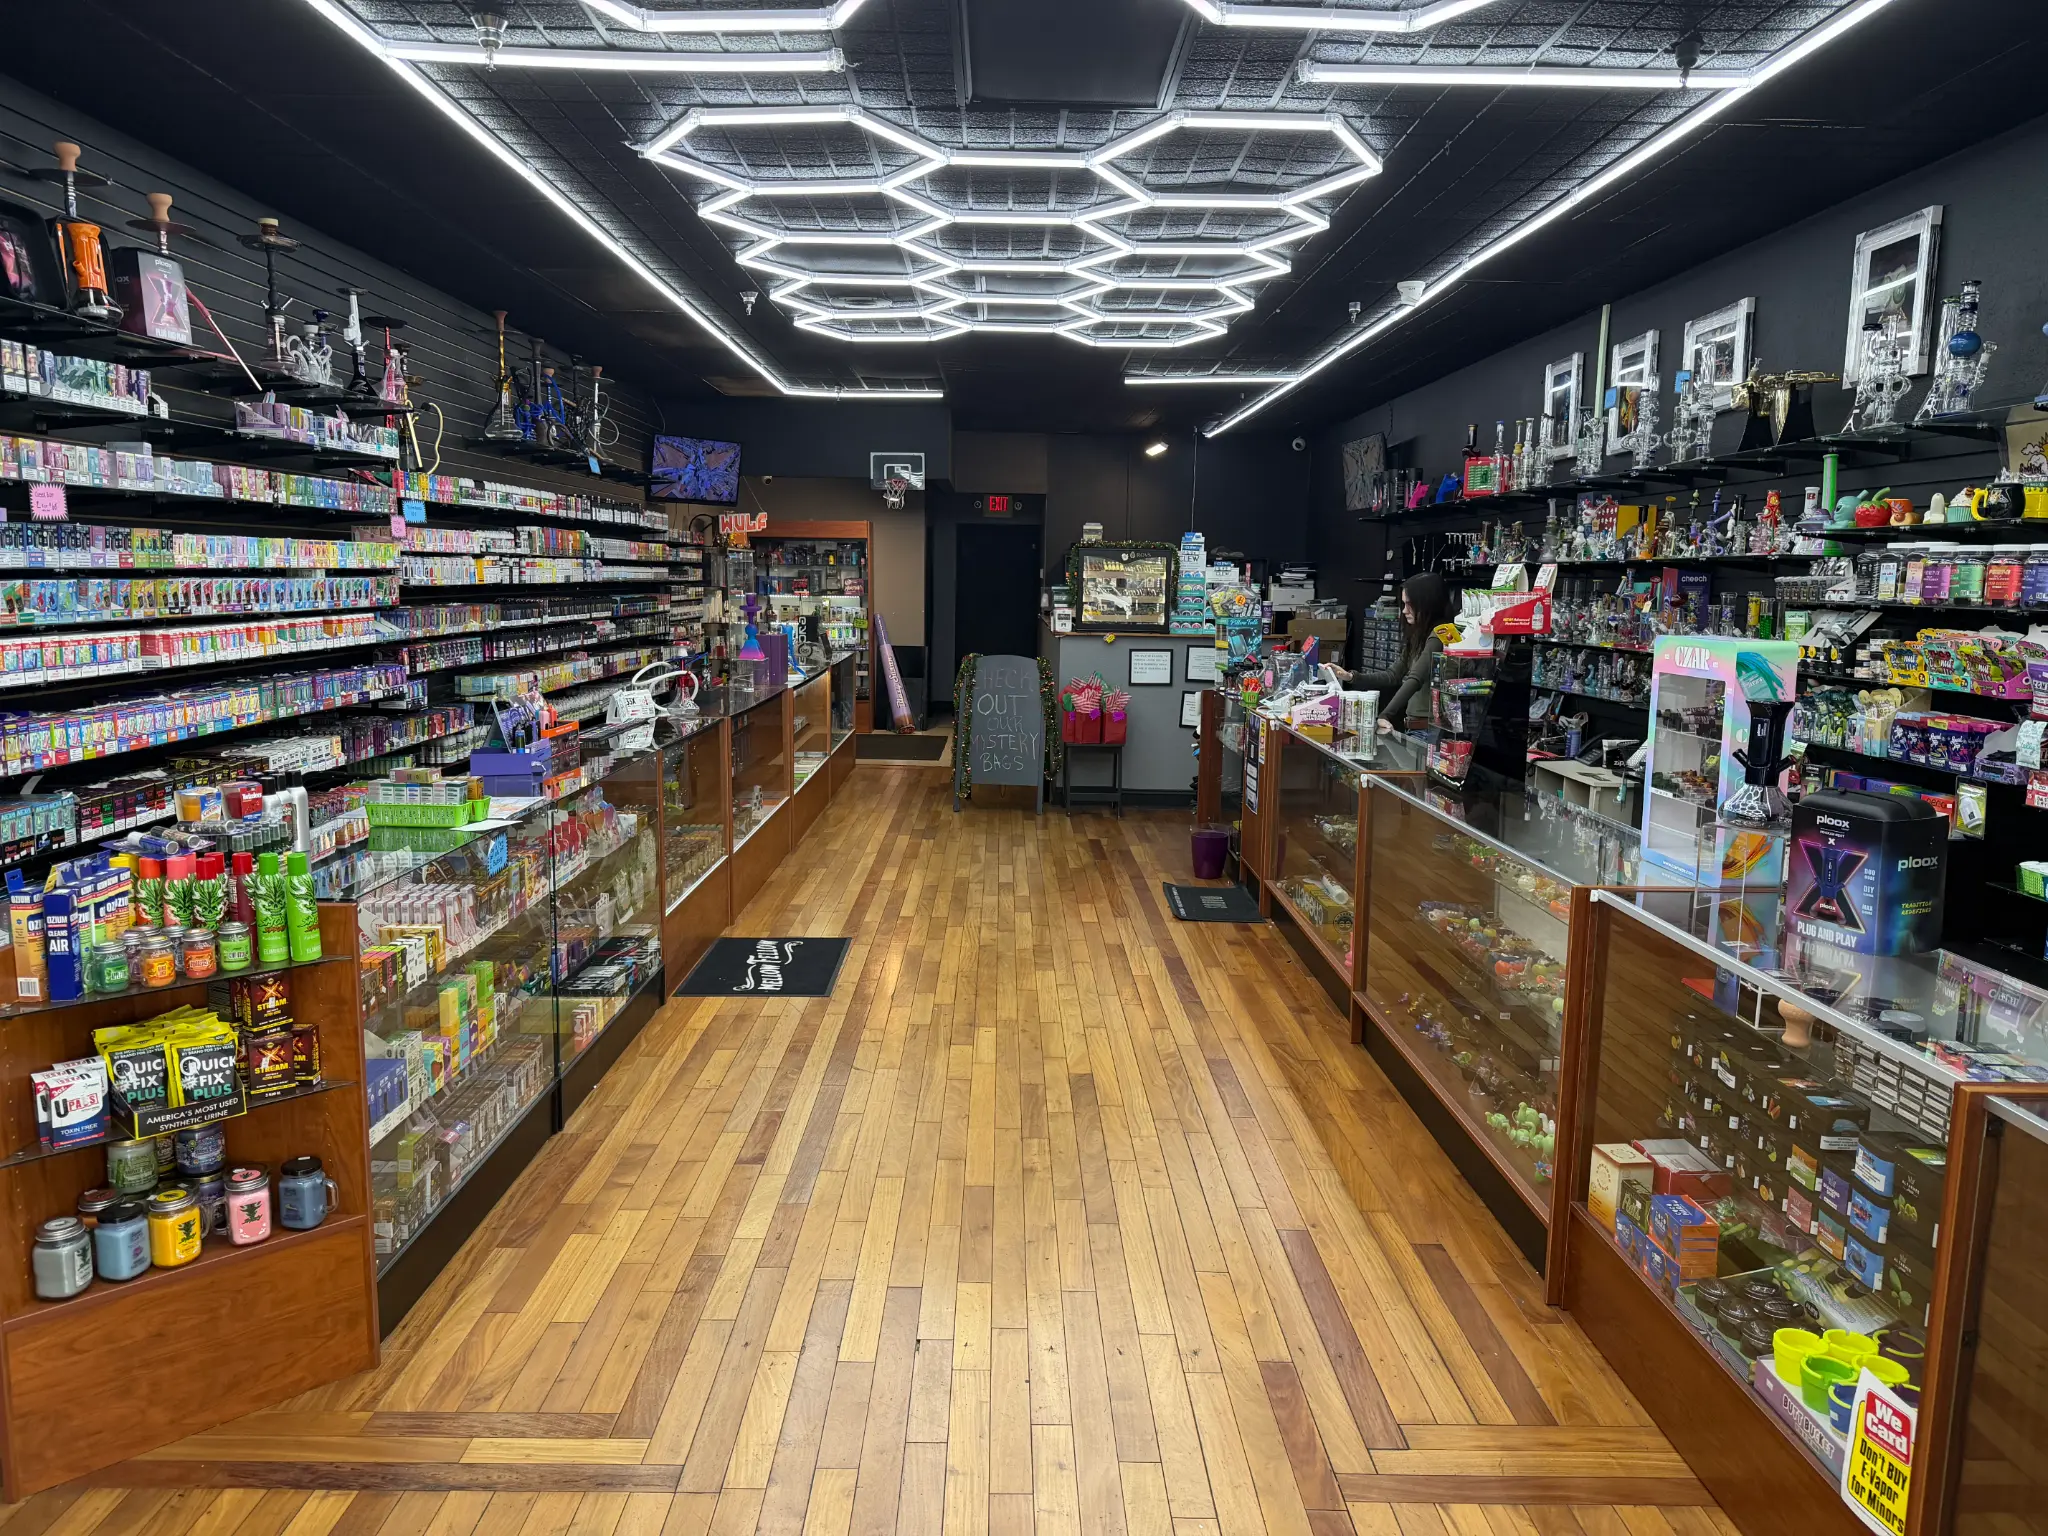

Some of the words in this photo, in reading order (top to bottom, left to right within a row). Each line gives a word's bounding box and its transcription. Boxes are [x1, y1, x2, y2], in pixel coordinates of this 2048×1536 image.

[989, 496, 1008, 512] EXIT
[719, 512, 768, 534] WULF
[888, 655, 899, 684] Susan
[1675, 646, 1710, 671] CZAR
[978, 693, 1028, 716] OUT
[988, 716, 1024, 734] OUR
[970, 732, 1039, 760] MYSTERY
[980, 752, 1024, 772] BAGS
[1816, 815, 1850, 828] ploox
[1898, 856, 1939, 872] ploox
[1820, 903, 1836, 912] ploox
[50, 939, 69, 952] AIR
[1797, 921, 1817, 937] PLUG
[1818, 927, 1834, 942] AND
[1836, 932, 1857, 948] PLAY
[752, 939, 781, 964] FELLOW
[758, 964, 784, 990] MELLOW
[180, 1055, 236, 1076] QUICK
[255, 1063, 288, 1074] STREAM
[200, 1072, 225, 1087] FIX
[127, 1086, 165, 1103] PLUS
[193, 1083, 232, 1100] PLUS
[54, 1092, 98, 1118] UPAS
[146, 1107, 193, 1125] AMERICA'S
[195, 1104, 218, 1115] MOST
[218, 1097, 238, 1109] USED
[60, 1127, 80, 1135] TOXIN
[81, 1123, 98, 1131] FREE
[159, 1117, 201, 1132] SYNTHETIC
[204, 1110, 228, 1121] URINE
[1782, 1394, 1803, 1425] BUTT
[1804, 1417, 1835, 1460] BUCKET
[1875, 1399, 1902, 1433] We
[1866, 1412, 1908, 1455] Card
[1860, 1438, 1885, 1472] Don't
[1887, 1461, 1908, 1492] BUY
[1861, 1461, 1899, 1505] E-Vapor
[1851, 1475, 1866, 1499] for
[1867, 1488, 1904, 1534] Minors
